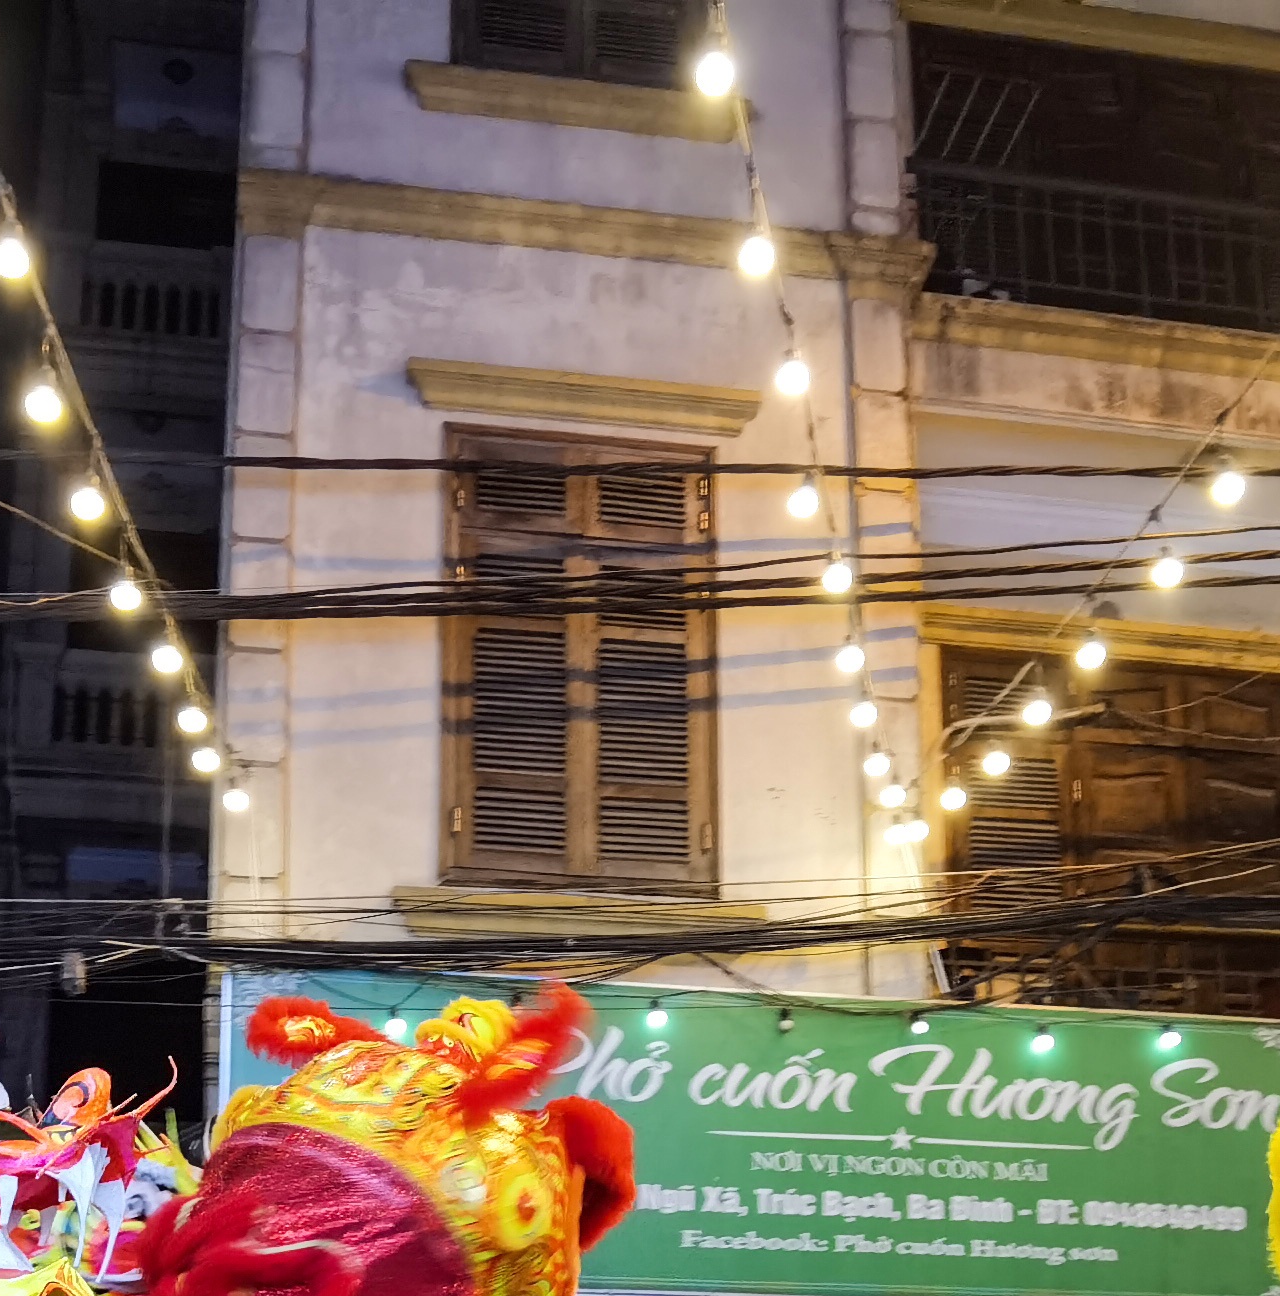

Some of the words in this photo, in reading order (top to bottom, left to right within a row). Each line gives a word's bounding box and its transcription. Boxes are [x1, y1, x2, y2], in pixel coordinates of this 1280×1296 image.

[687, 1048, 858, 1113] cuốn
[749, 1150, 804, 1173] NƠI
[808, 1153, 841, 1176] VỊ
[841, 1154, 925, 1177] NGON
[753, 1187, 817, 1216] Trúc
[906, 1193, 946, 1220] Ba
[949, 1195, 1014, 1223] Đình
[678, 1230, 828, 1252] Facebook:
